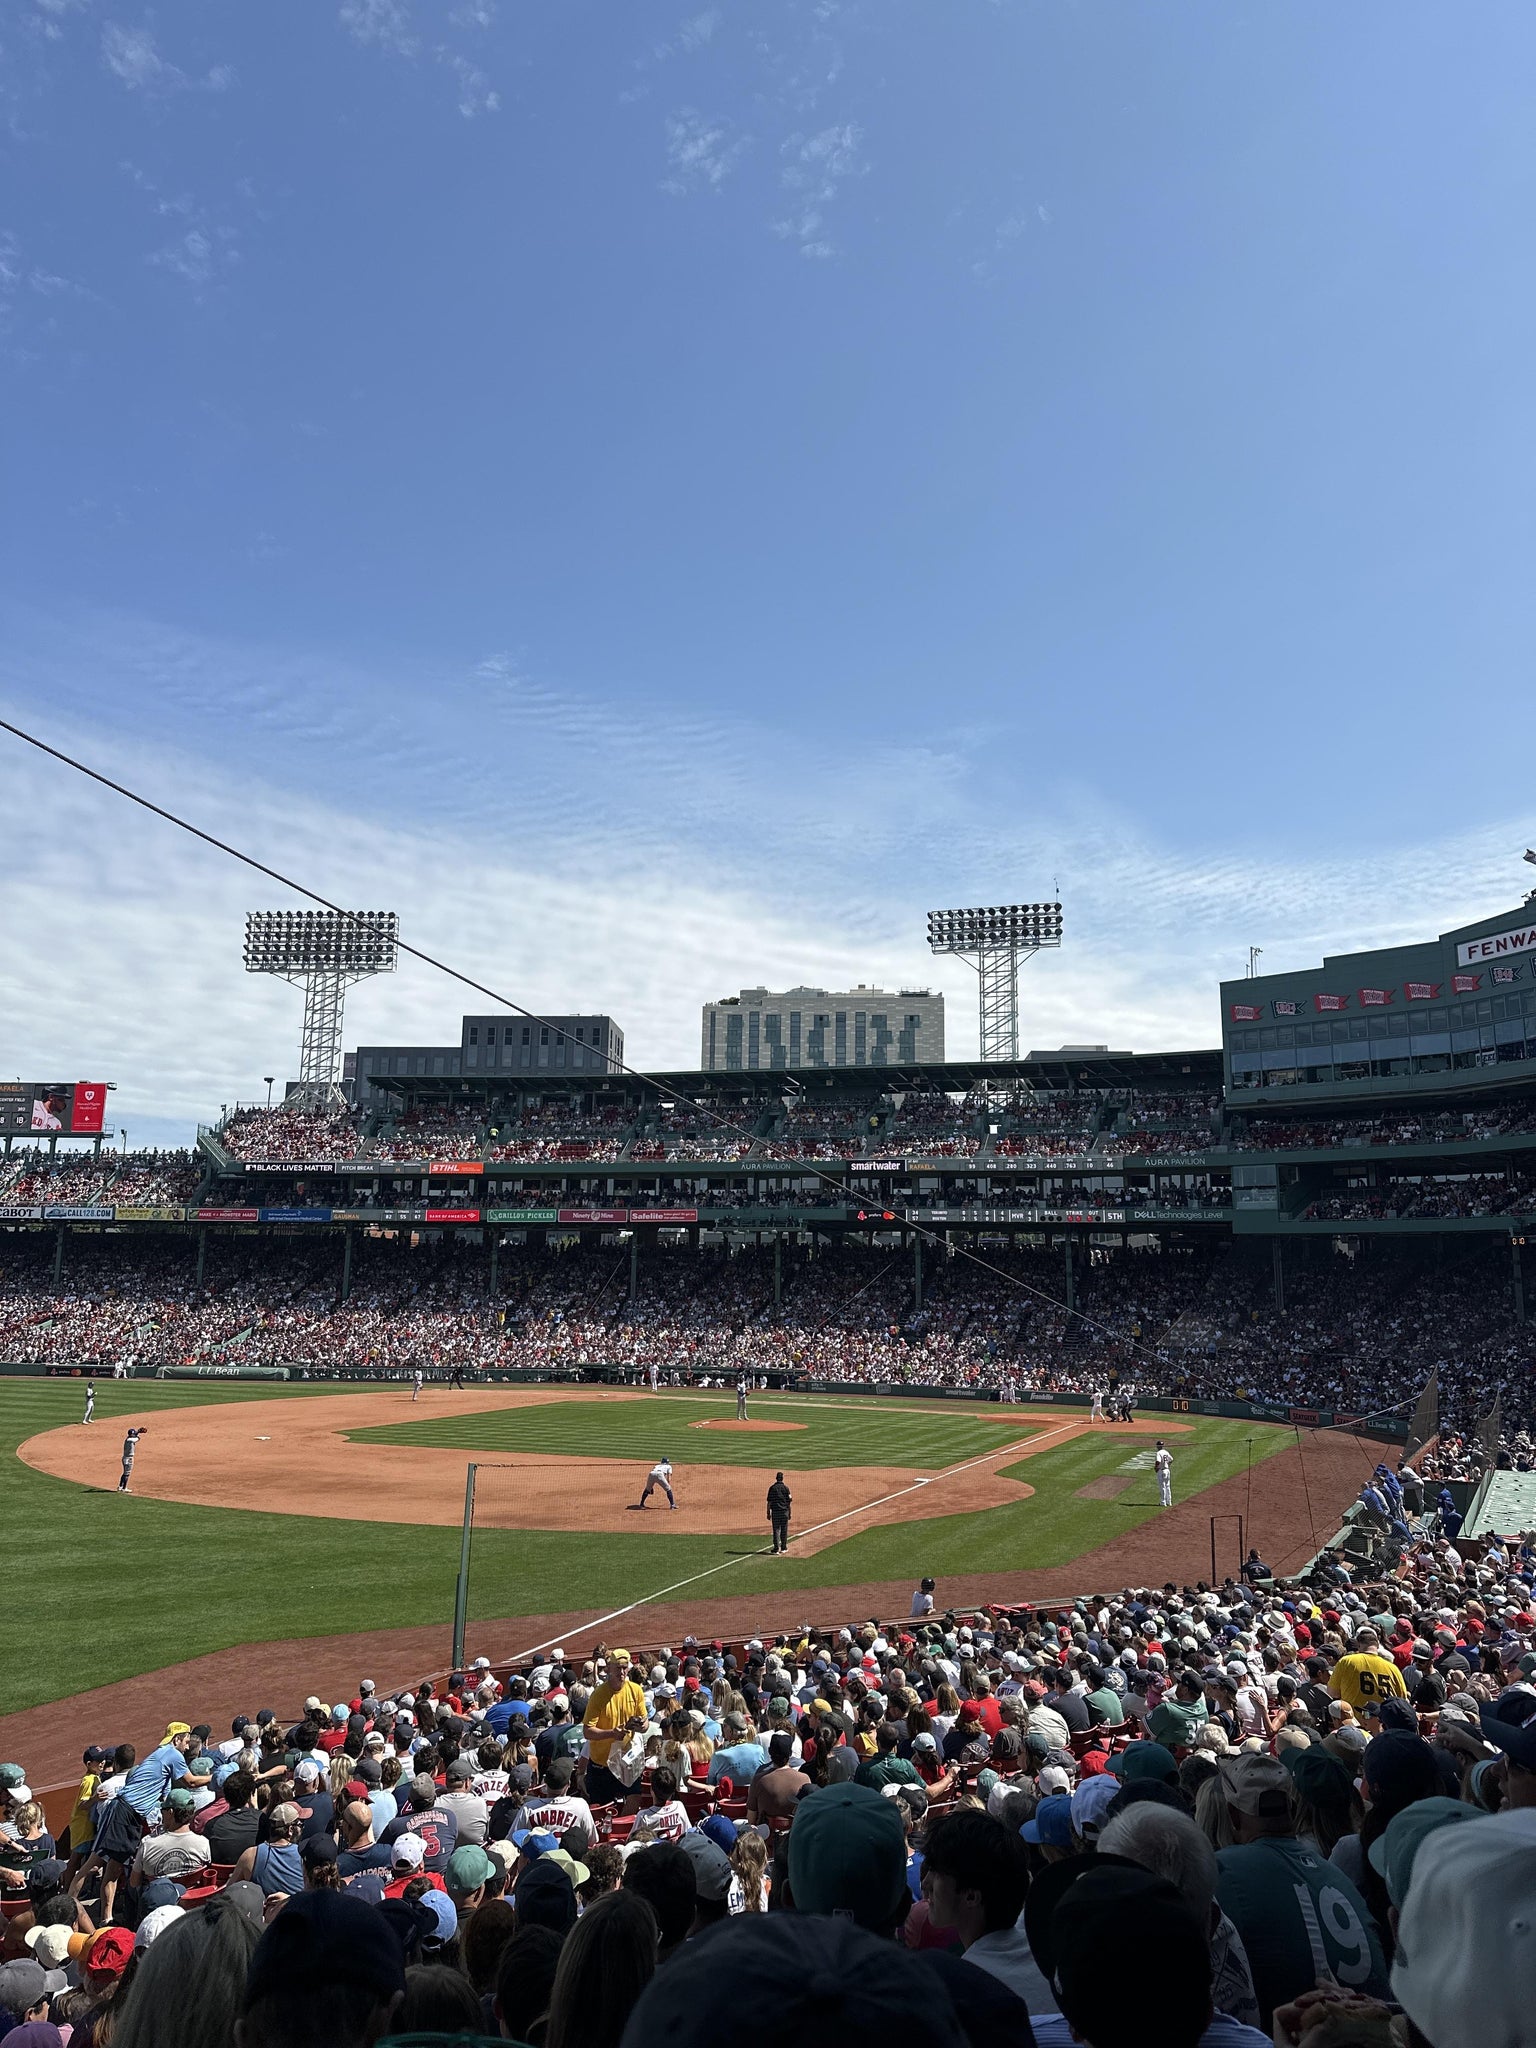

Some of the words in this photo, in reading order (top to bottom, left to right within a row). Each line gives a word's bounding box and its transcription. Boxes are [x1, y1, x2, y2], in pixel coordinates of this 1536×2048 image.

[1468, 930, 1536, 959] FENWA
[851, 1162, 900, 1170] smartwater
[573, 1212, 590, 1220] Ninety
[632, 1212, 663, 1220] Safelite
[1359, 1670, 1391, 1699] 65
[660, 1812, 679, 1828] ORTIZ
[421, 1824, 440, 1857] 5
[1293, 1884, 1372, 1985] 19
